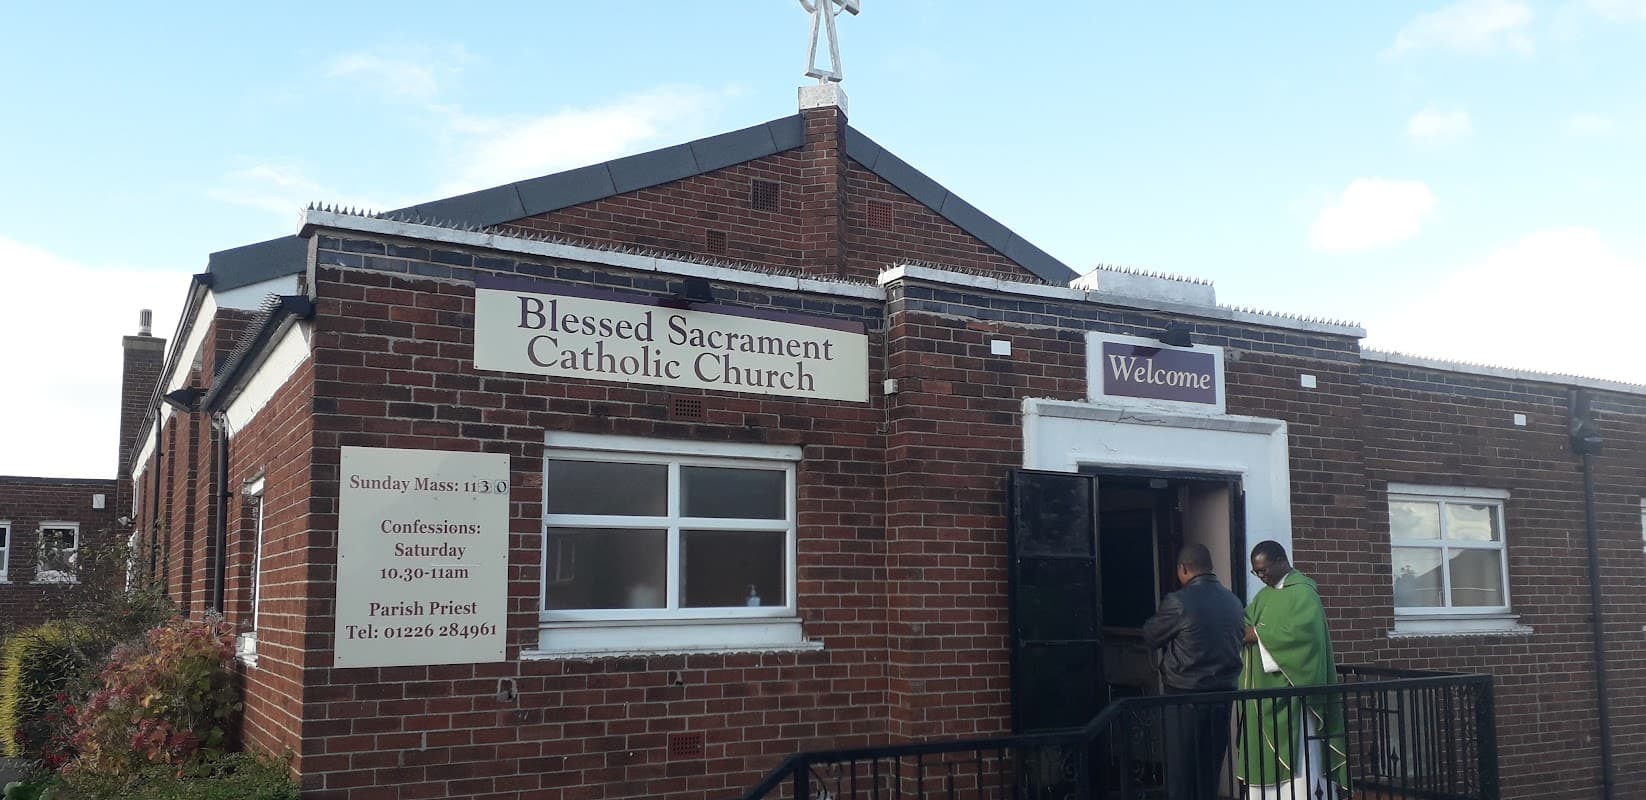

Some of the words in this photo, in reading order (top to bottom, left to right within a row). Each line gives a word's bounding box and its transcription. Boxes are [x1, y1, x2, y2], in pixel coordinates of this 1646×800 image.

[517, 296, 654, 342] Blessed
[667, 315, 834, 361] Sacrament
[527, 334, 681, 379] Catholic
[694, 352, 815, 392] Church
[1108, 354, 1211, 390] Welcome
[349, 474, 410, 493] Sunday
[414, 477, 459, 492] Mass:
[381, 519, 481, 534] Confessions:
[394, 542, 466, 560] Saturday
[380, 567, 469, 582] 10.30-11am
[368, 601, 424, 616] Parish
[429, 600, 478, 615] Priest
[346, 624, 379, 639] Tel:
[384, 624, 434, 639] 01226
[439, 622, 497, 639] 284961
